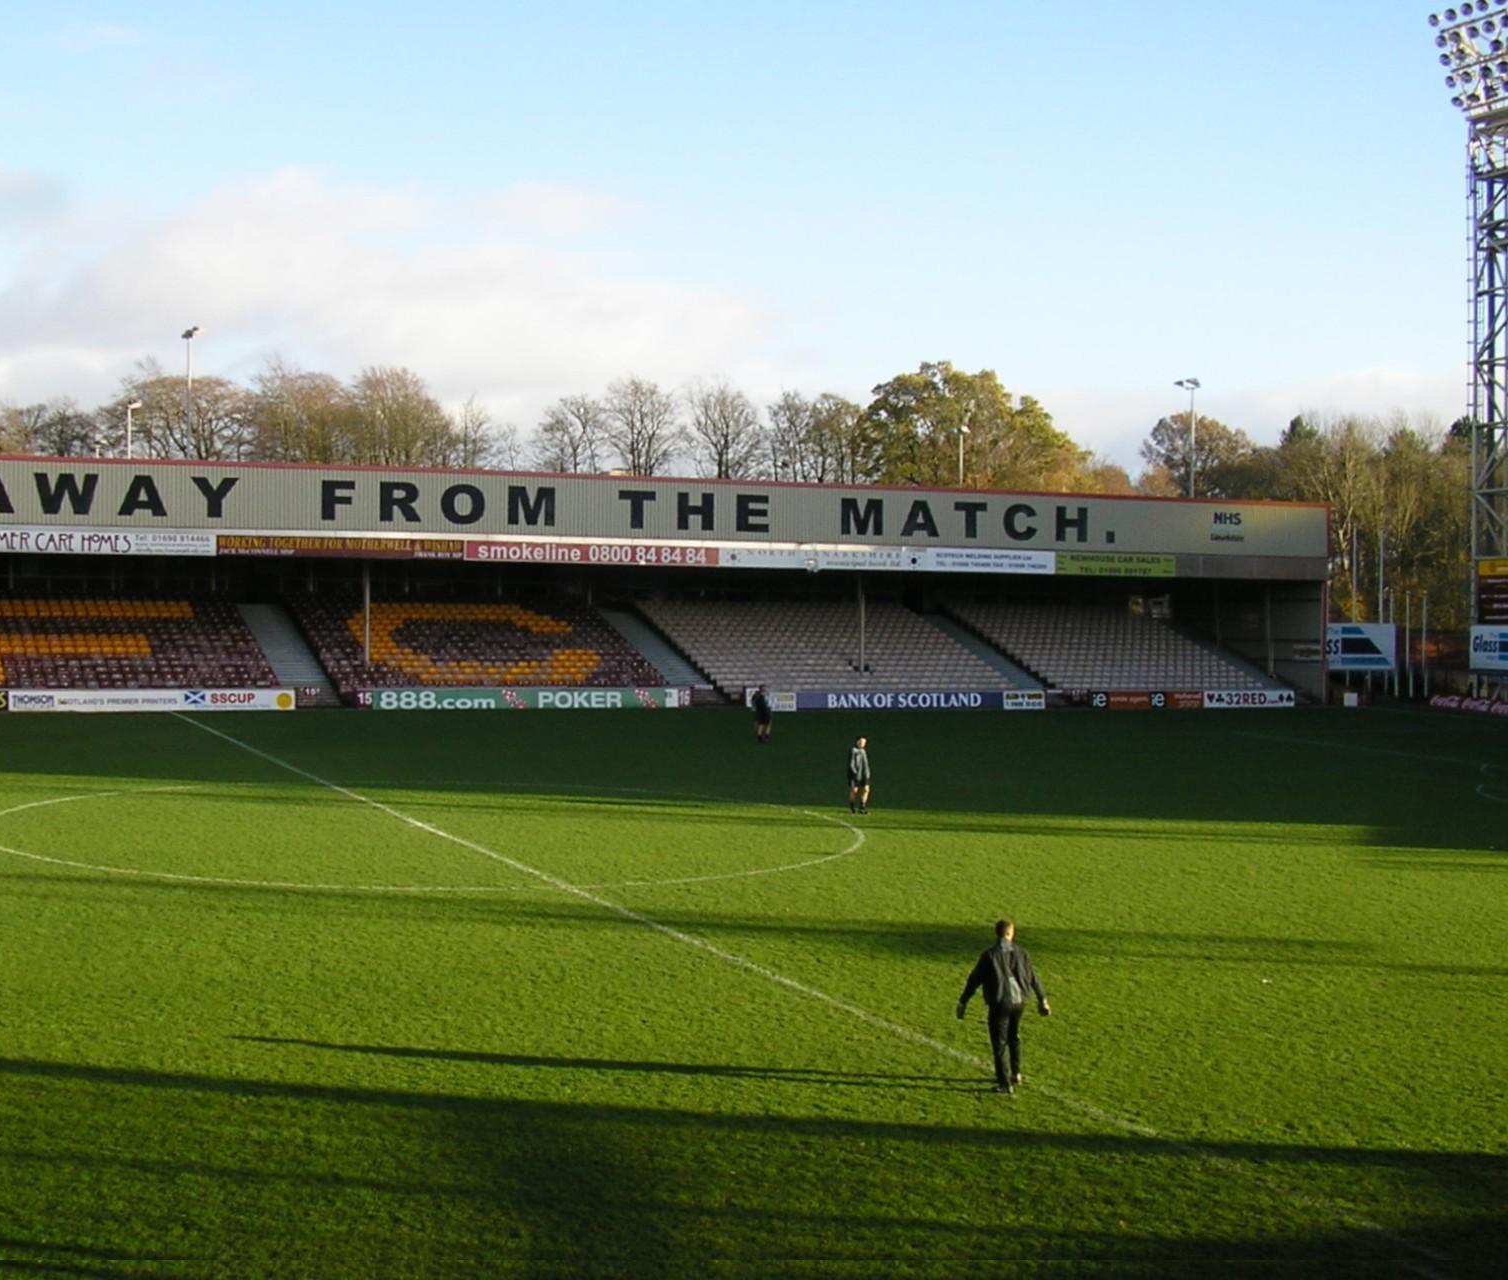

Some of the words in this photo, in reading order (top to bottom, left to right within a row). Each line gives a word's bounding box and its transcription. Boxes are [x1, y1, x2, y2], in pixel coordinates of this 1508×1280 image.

[320, 479, 556, 526] FROM
[618, 489, 770, 533] THE
[840, 497, 1116, 544] MATCH.
[1213, 511, 1243, 525] NHS
[34, 533, 75, 552] CARE
[81, 534, 132, 553] HOMES
[218, 535, 267, 549] WORKING
[269, 536, 322, 550] TOGETHER
[346, 538, 412, 552] MOTHERWELL
[477, 543, 581, 561] smokeline
[589, 545, 632, 562] 0800
[636, 546, 657, 563] 84
[662, 547, 682, 563] 84
[686, 548, 707, 564] 84
[1473, 635, 1498, 653] Glass
[12, 694, 55, 707] THOMSON
[210, 693, 256, 704] SSCUP
[358, 692, 372, 705] 15
[380, 690, 495, 709] 888.com
[538, 691, 623, 708] POKER
[827, 694, 872, 709] BANK
[874, 694, 894, 708] OF
[898, 693, 982, 708] SCOTLAND
